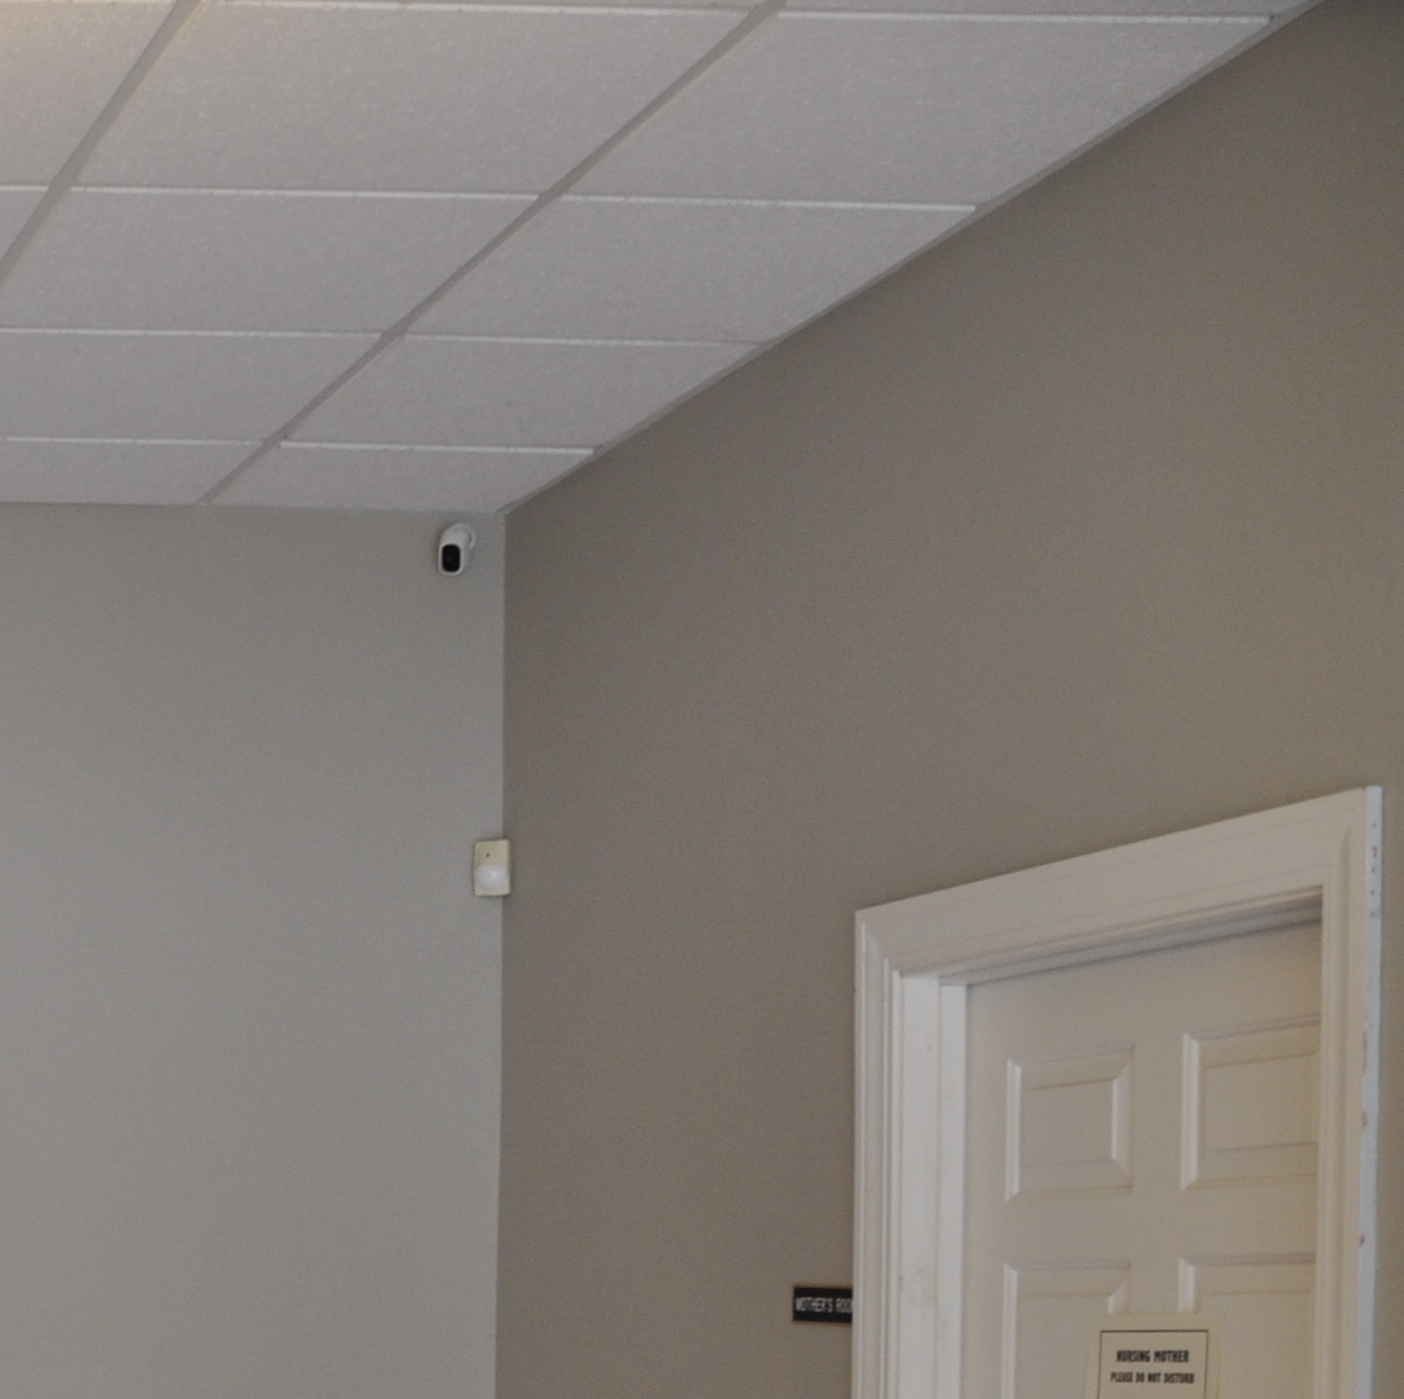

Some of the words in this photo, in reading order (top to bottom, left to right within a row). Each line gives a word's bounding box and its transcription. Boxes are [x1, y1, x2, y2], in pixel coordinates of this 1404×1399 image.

[1154, 1350, 1189, 1363] MOTHER
[1110, 1371, 1134, 1383] PLEASE
[1135, 1372, 1145, 1383] DO
